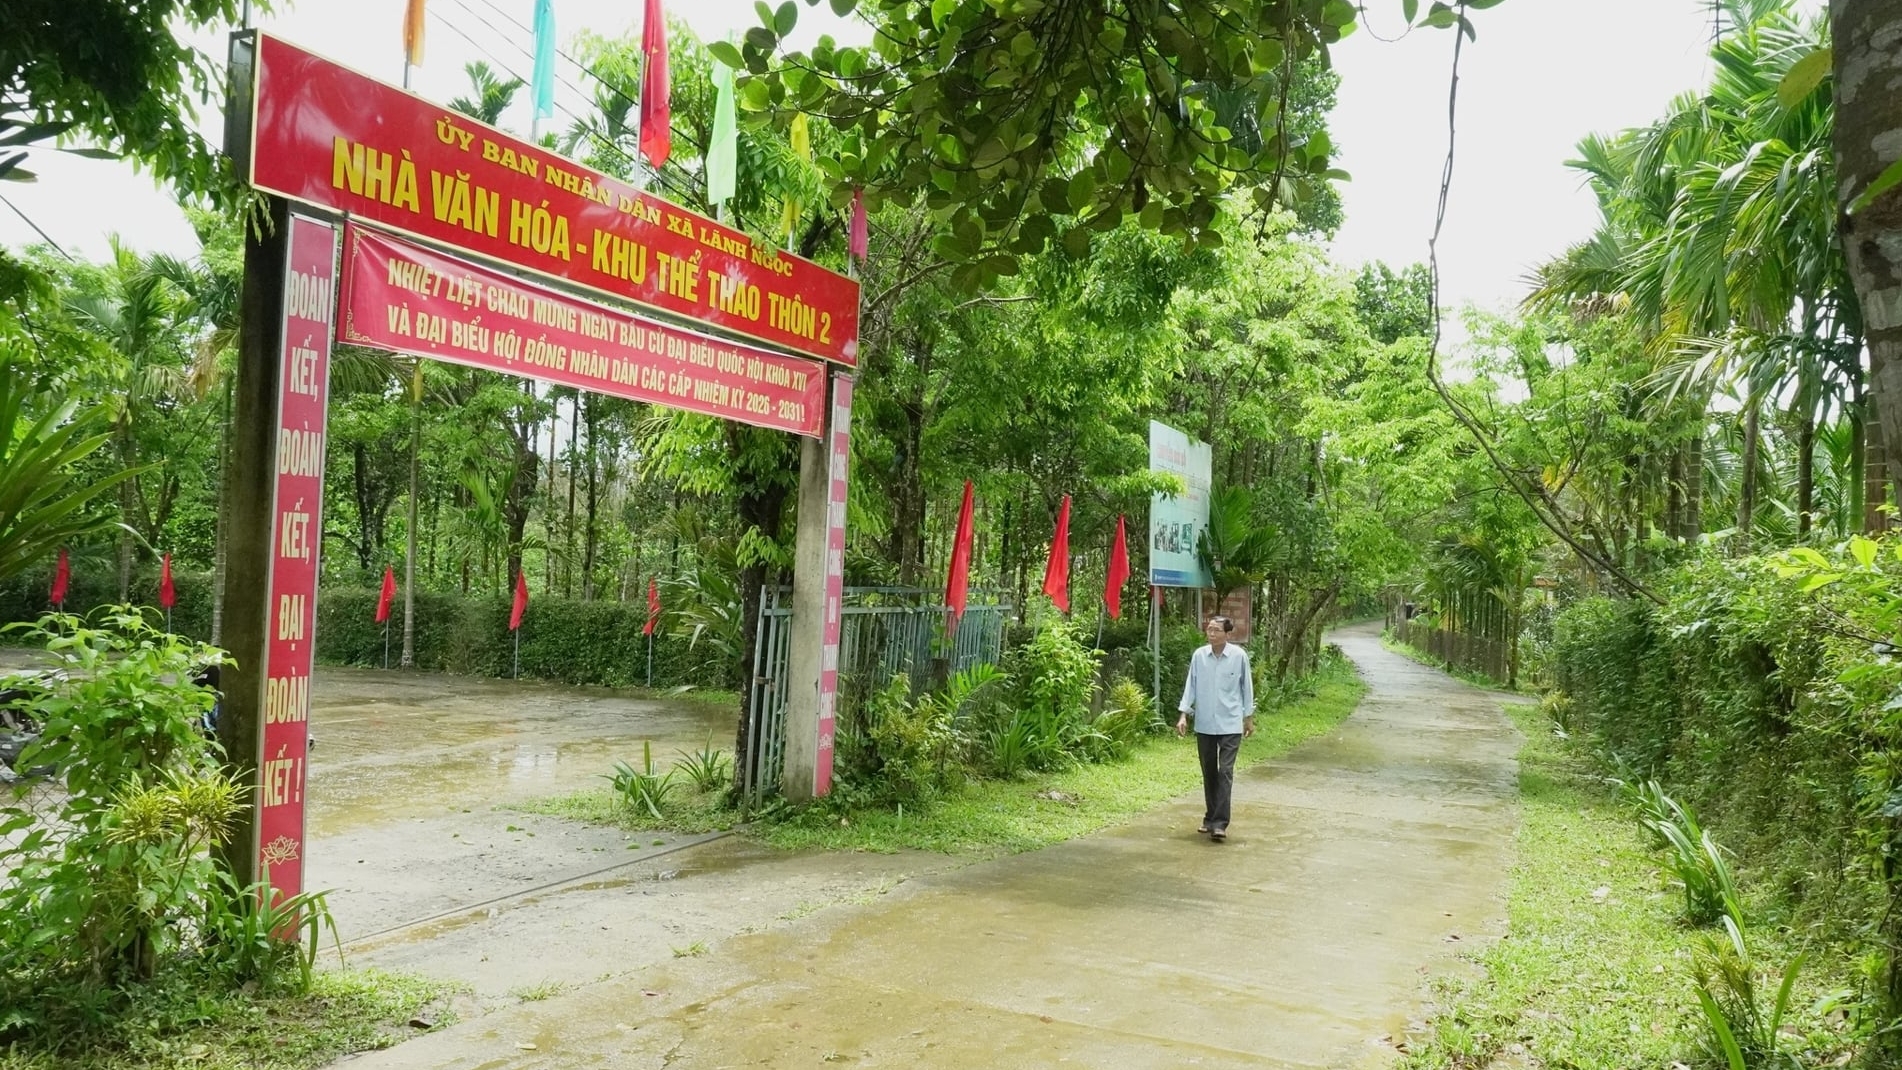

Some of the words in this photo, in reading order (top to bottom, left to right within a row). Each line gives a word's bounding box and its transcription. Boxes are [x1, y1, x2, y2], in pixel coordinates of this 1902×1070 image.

[435, 114, 475, 152] ỦY
[482, 138, 539, 179] BAN
[545, 164, 613, 207] NHÂN
[618, 193, 662, 226] DÂN
[666, 213, 696, 240] XÃ
[699, 226, 747, 260] LÃNH
[332, 135, 421, 214] NHÀ
[431, 169, 500, 239] VĂN
[509, 198, 571, 262] HÓA
[592, 228, 647, 285] KHU
[656, 249, 702, 303] THỂ
[707, 270, 761, 323] THAO
[768, 292, 816, 341] THÔN
[819, 311, 832, 345] 2
[288, 265, 329, 323] ĐOÀN
[387, 257, 445, 301] NHIỆT
[446, 273, 483, 312] LIỆT
[487, 285, 529, 320] CHÀO
[580, 312, 617, 343] NGÀY
[648, 326, 665, 356] CỬ
[667, 335, 687, 365] ĐẠI
[689, 338, 715, 369] BIỂU
[717, 348, 745, 376] QUỐC
[746, 356, 764, 384] HỘI
[765, 363, 790, 389] KHÓA
[290, 334, 319, 402] KẾT,
[387, 301, 411, 337] VÀ
[415, 311, 447, 348] ĐẠI
[451, 315, 490, 354] BIỂU
[493, 329, 522, 365] HỘI
[569, 349, 609, 381] NHÂN
[611, 356, 638, 387] DÂN
[641, 364, 666, 393] CÁC
[668, 368, 692, 398] CẤP
[694, 379, 729, 409] NHIỆM
[730, 385, 745, 410] KỲ
[746, 391, 770, 415] 2026
[778, 399, 805, 422] 2031!
[280, 421, 321, 478] ĐOÀN
[281, 497, 310, 565] KẾT,
[279, 594, 305, 651] ĐẠI
[265, 667, 308, 725] ĐOÀN
[263, 743, 294, 808] KẾT
